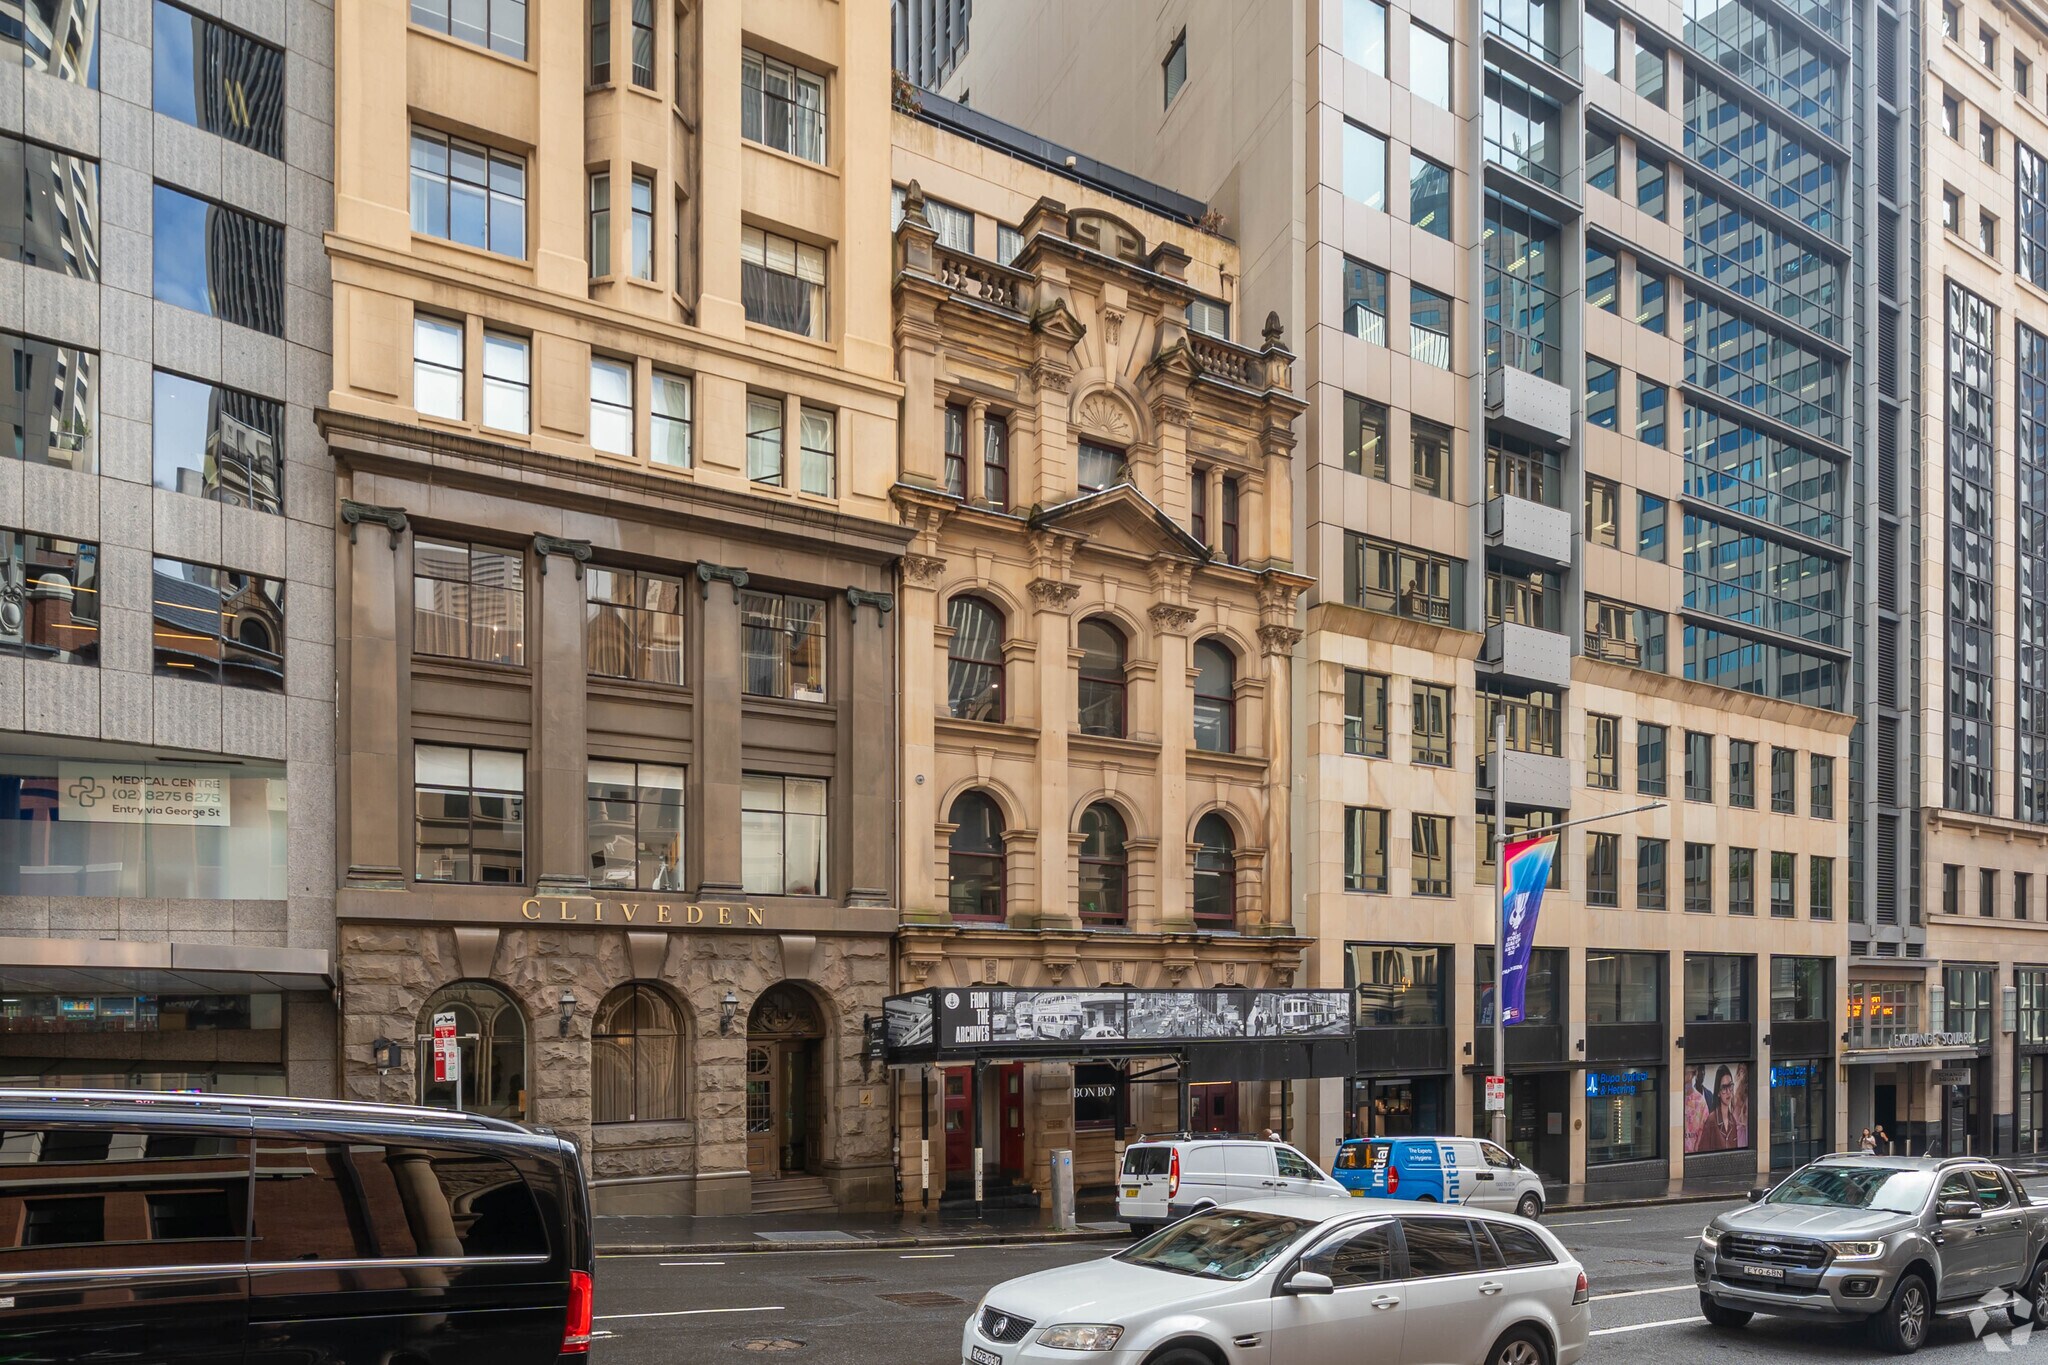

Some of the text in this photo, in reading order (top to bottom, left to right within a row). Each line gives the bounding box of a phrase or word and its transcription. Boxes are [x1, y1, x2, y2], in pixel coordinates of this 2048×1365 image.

[112, 775, 220, 789] MEDICAL CENTRE
[112, 789, 221, 803] (02) 8275 6275
[112, 804, 220, 818] Entry via George St
[521, 899, 765, 926] CLIVEDEN
[970, 992, 989, 1008] FROM
[976, 1009, 989, 1025] THE
[955, 1025, 989, 1043] ARCHIVES
[1894, 1032, 1973, 1047] EXCHANGE SQUARE
[1600, 1073, 1620, 1083] Bupa
[1073, 1087, 1095, 1098] BON
[1600, 1084, 1636, 1096] & Hearing
[1372, 1146, 1390, 1187] Initial
[1440, 1146, 1460, 1204] Initial
